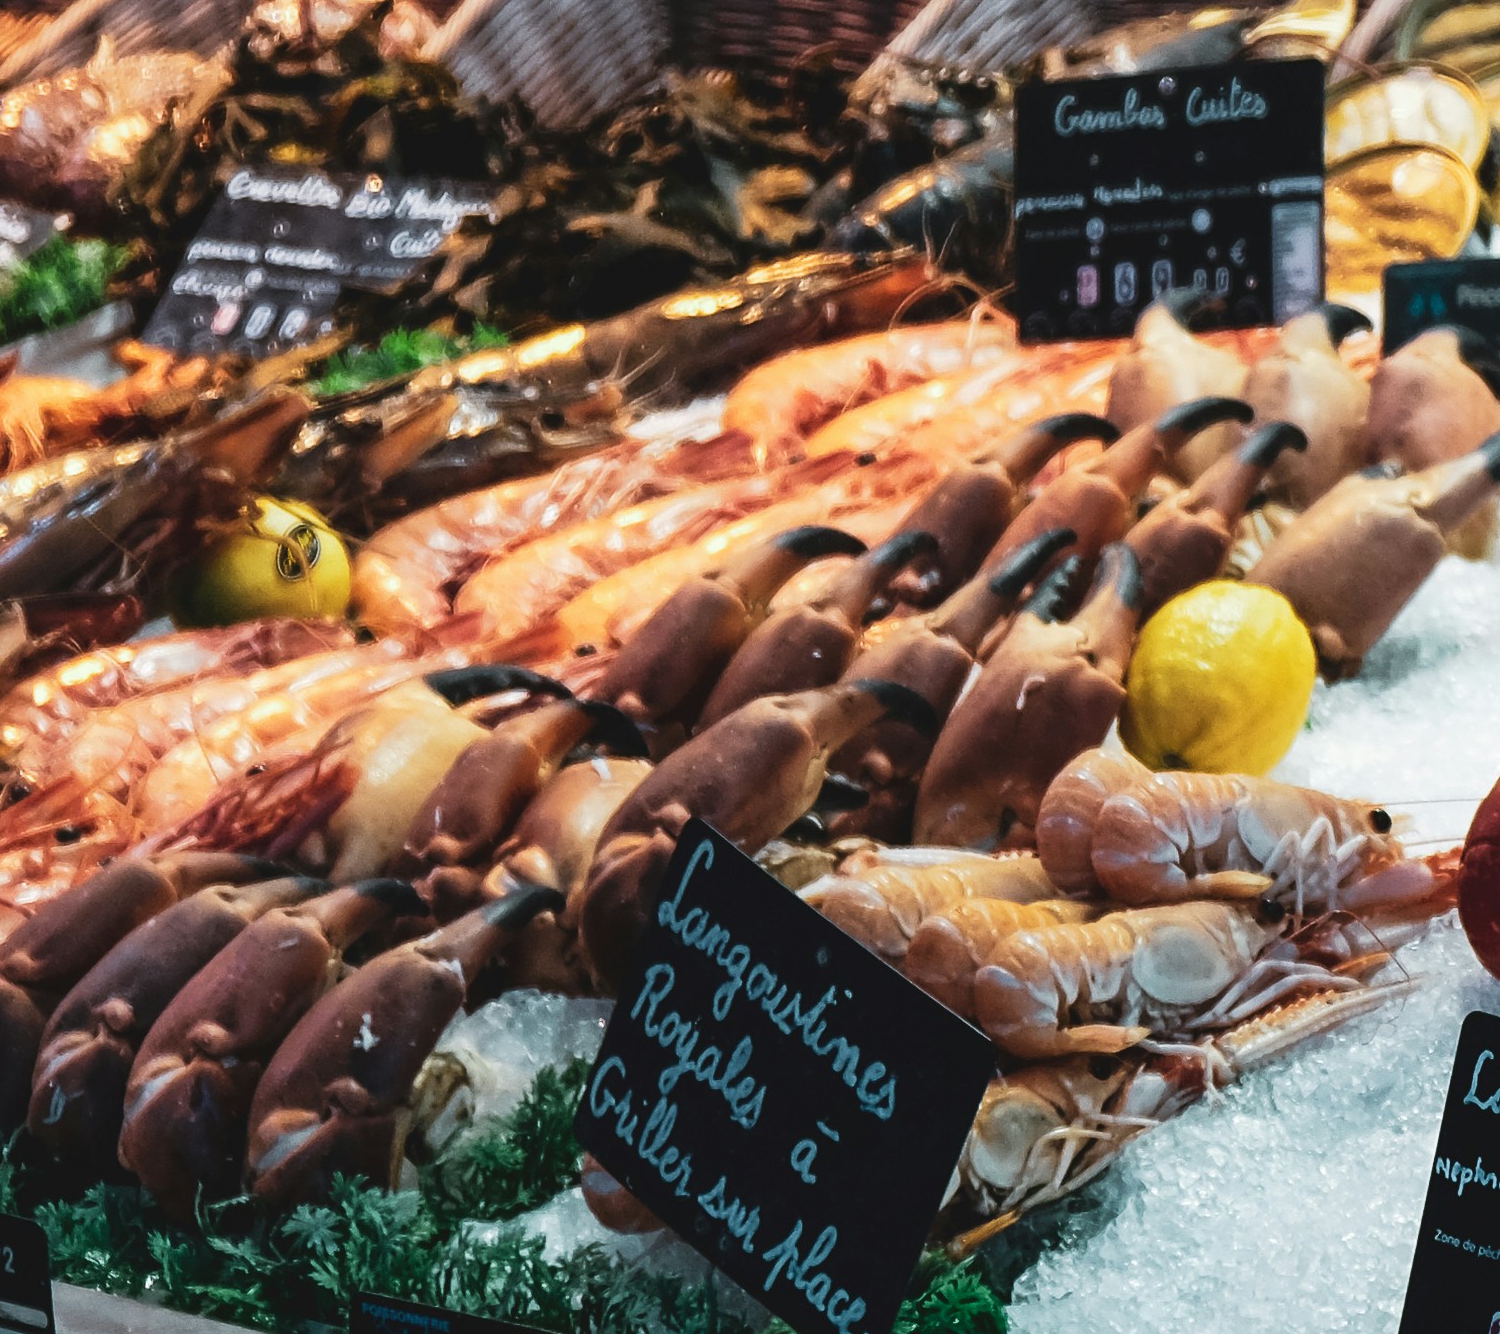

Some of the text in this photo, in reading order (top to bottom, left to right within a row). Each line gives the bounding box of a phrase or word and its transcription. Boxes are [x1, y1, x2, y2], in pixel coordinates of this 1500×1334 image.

[630, 962, 768, 1130] Royales
[657, 837, 897, 1122] Langoustines
[589, 1056, 691, 1198] Griller
[698, 1174, 755, 1254] sur
[790, 1119, 841, 1185] à
[1434, 1228, 1461, 1248] Zone
[1462, 1238, 1476, 1253] de
